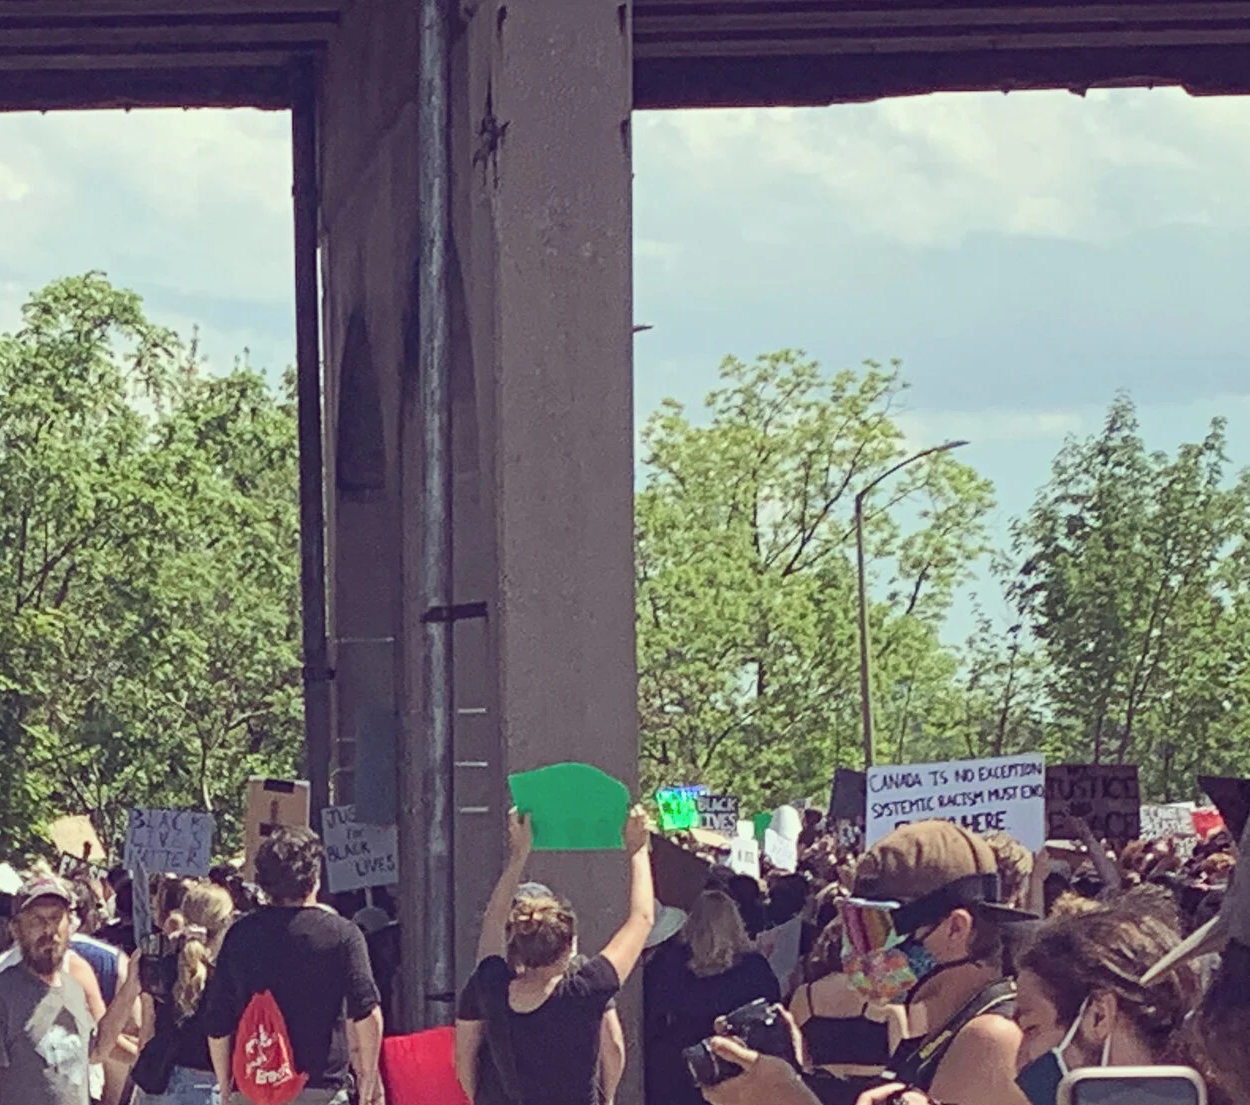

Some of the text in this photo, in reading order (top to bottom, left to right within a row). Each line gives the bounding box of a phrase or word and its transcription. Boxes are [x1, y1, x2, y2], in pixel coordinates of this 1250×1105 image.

[869, 762, 1042, 793] CANADA IS NO EXCEPTION
[871, 797, 935, 819] SYSTEMIC
[938, 790, 985, 808] RACISM
[988, 785, 1019, 801] MUST
[131, 808, 203, 832] BLACK
[326, 840, 371, 863] BLACK
[354, 853, 395, 876] LIVES
